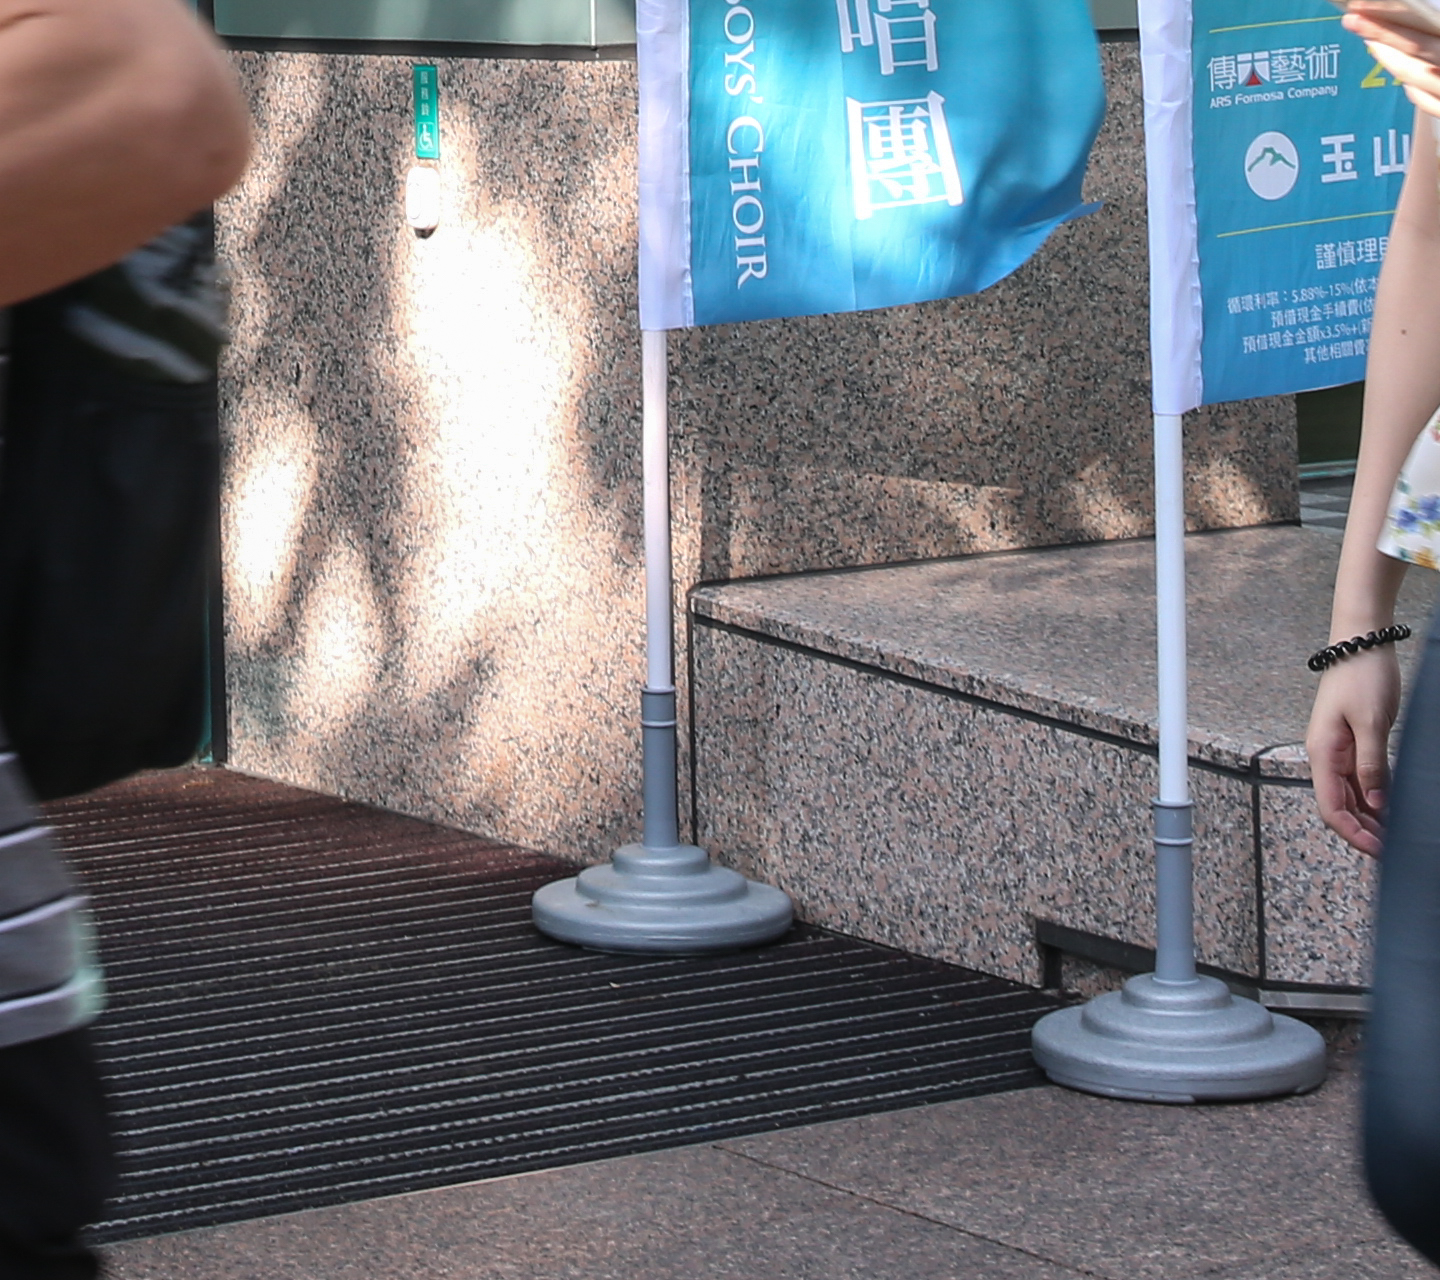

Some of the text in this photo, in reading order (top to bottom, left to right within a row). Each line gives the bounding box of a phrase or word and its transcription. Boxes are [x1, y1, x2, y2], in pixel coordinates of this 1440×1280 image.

[1209, 84, 1338, 109] ARS Formosa Company
[725, 115, 768, 289] CHOIR
[1304, 339, 1370, 364] 其他相關費
